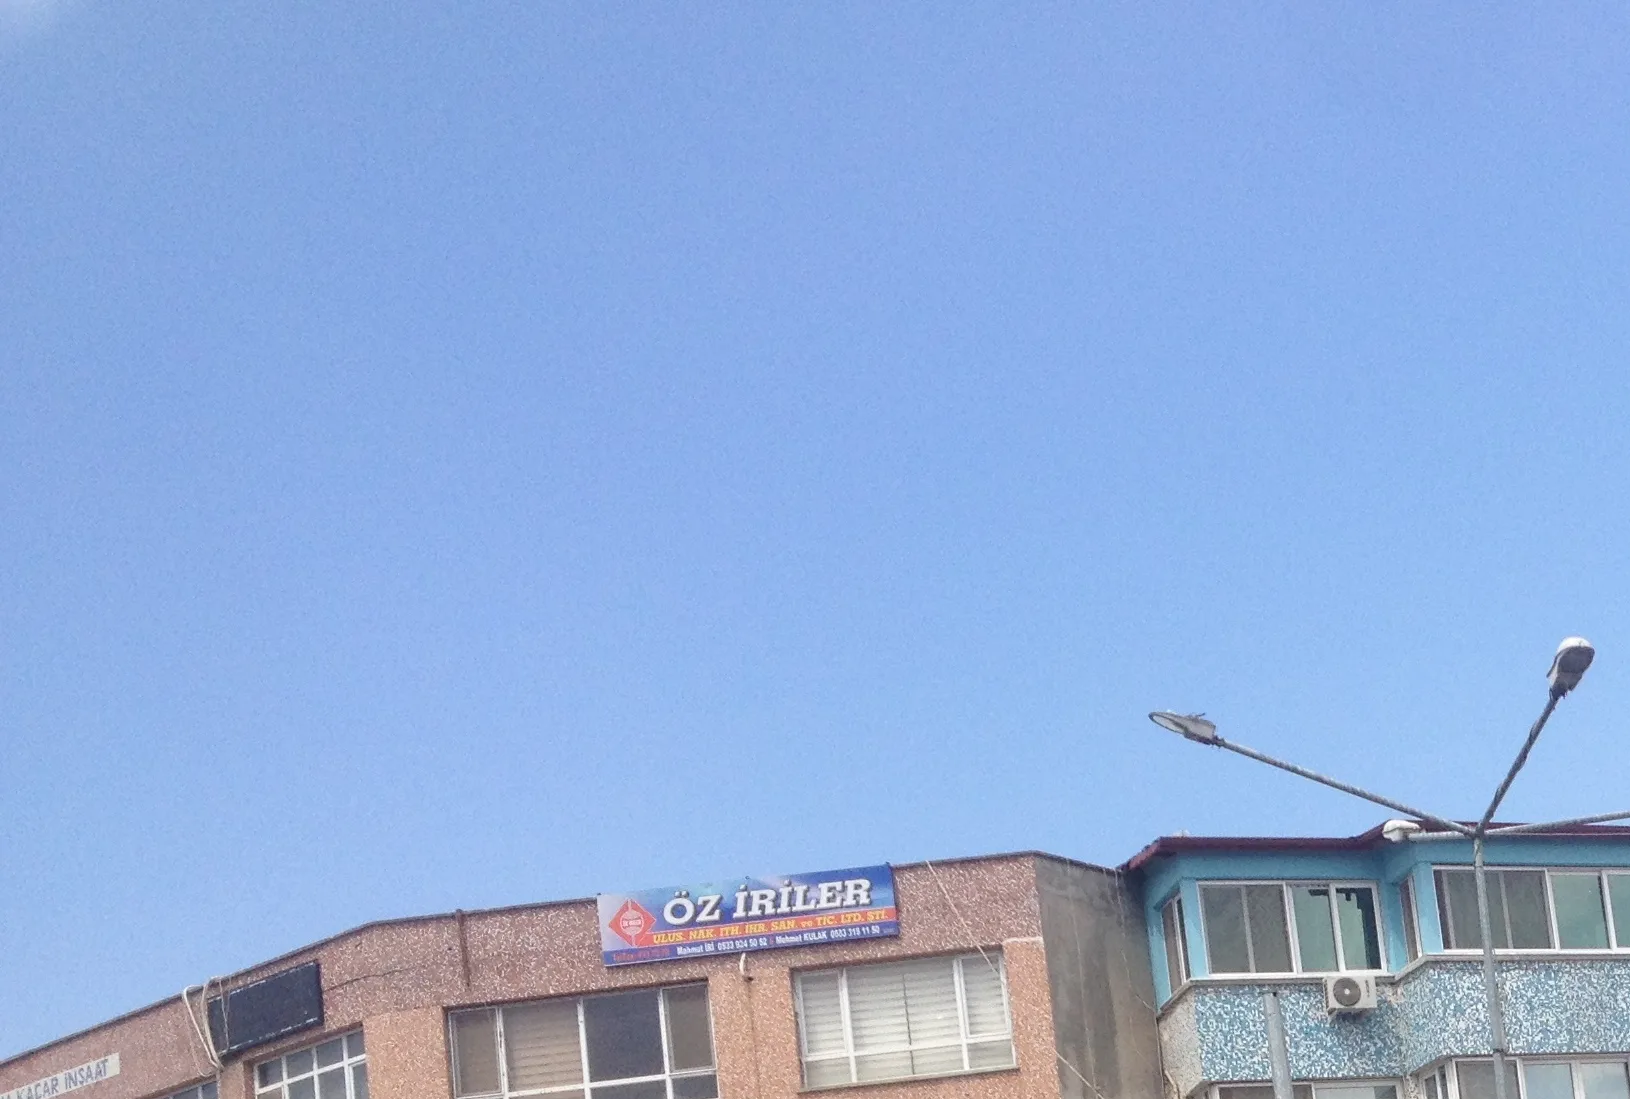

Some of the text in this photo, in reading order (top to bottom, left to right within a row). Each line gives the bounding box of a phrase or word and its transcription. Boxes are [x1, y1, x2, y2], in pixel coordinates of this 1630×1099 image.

[663, 878, 872, 926] ÖZ İRİLER
[771, 918, 798, 931] SAN.
